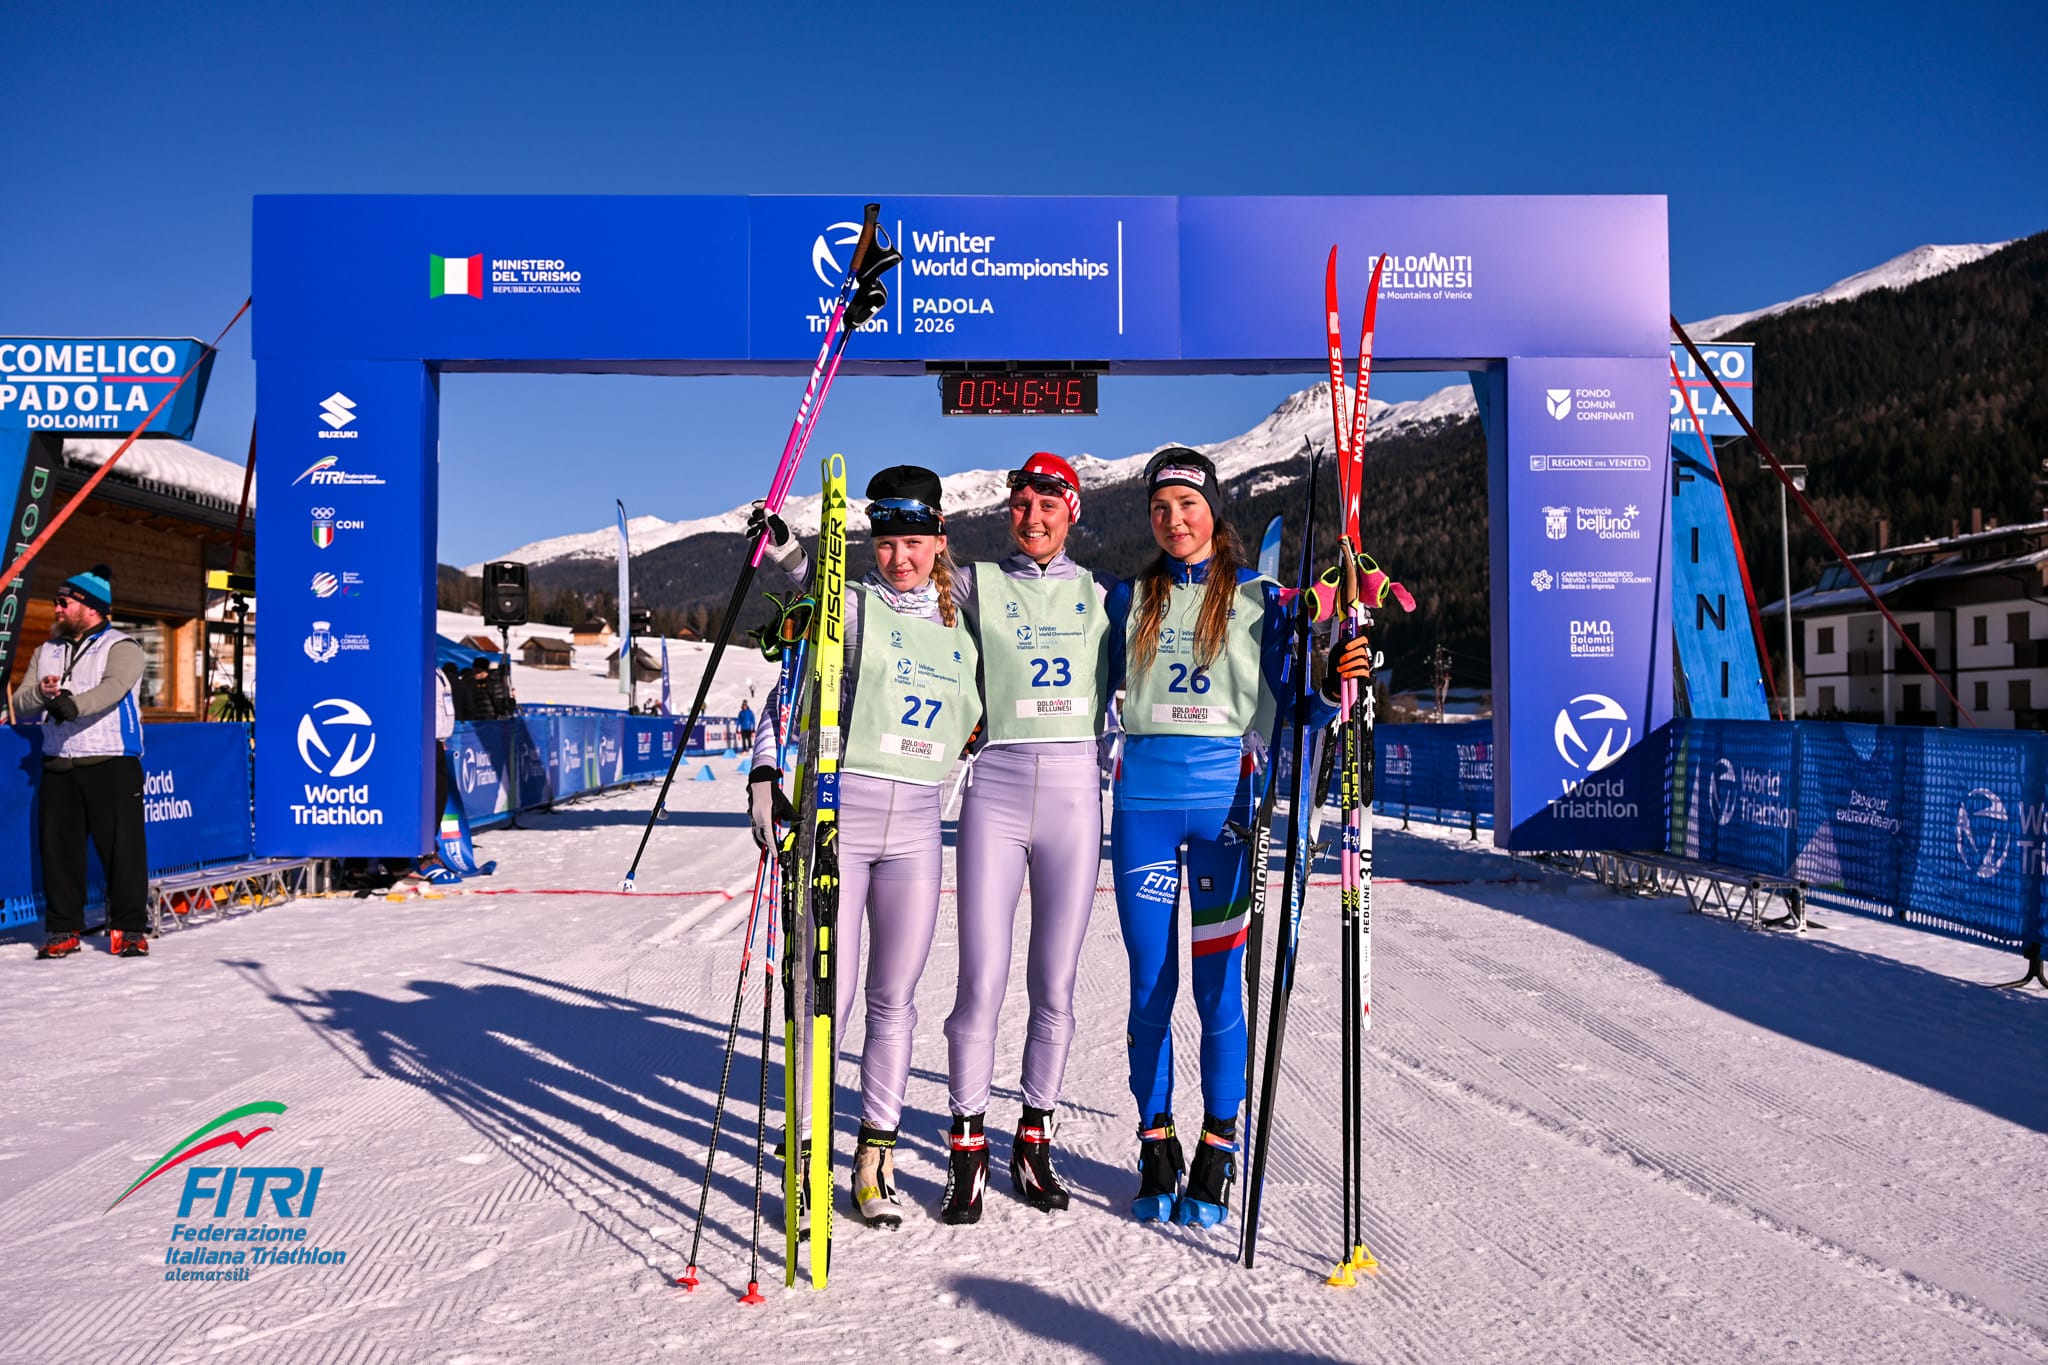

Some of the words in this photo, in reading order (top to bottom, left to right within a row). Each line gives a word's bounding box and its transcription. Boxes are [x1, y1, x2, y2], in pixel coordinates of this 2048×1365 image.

[912, 231, 995, 253] Winter
[492, 259, 565, 270] MINISTERO
[912, 258, 967, 276] World
[971, 258, 1109, 280] Championships
[1368, 252, 1472, 272] DOLOMITI
[492, 271, 518, 282] DEL
[521, 271, 581, 282] TURISMO
[493, 286, 542, 294] REPUBBLICA
[543, 286, 581, 294] ITALIANA
[1387, 291, 1431, 299] Mountains
[1433, 290, 1443, 299] of
[1444, 291, 1473, 299] Venice
[913, 299, 994, 314] PADOLA
[914, 318, 955, 333] 2026
[0, 345, 176, 374] COMELICO
[0, 385, 149, 412] PADOLA
[959, 380, 1081, 407] 00:46:46
[1576, 389, 1611, 398] FONDO
[1354, 356, 1371, 463] MADSHUS
[1576, 401, 1616, 409] COMUNI
[27, 414, 118, 429] DOLOMITI
[1576, 412, 1634, 421] CONFINANTI
[318, 431, 358, 439] SUZUKI
[1551, 458, 1593, 467] REGIONE
[1609, 458, 1646, 467] VENETO
[310, 471, 346, 485] FITRI
[1576, 507, 1612, 515] Provincia
[336, 520, 364, 529] CONI
[1576, 515, 1631, 534] belluno
[1599, 530, 1640, 539] dolomiti
[826, 517, 843, 644] FISCHER
[1570, 620, 1614, 635] D.M.O.
[1570, 635, 1614, 644] Dolomiti
[1570, 644, 1614, 653] Bellunesi
[1030, 657, 1072, 688] 23
[1168, 663, 1211, 694] 26
[1037, 699, 1072, 707] DOLOMITI
[1172, 706, 1208, 714] DOLOMITI
[900, 695, 943, 729] 27
[900, 744, 932, 755] BELLUNESI
[901, 738, 933, 750] DOLOMITI
[1561, 779, 1625, 798] World
[1740, 767, 1781, 797] World
[304, 784, 369, 804] World
[823, 791, 833, 803] 27
[1342, 771, 1350, 810] LEKI
[290, 805, 383, 825] Triathlon
[1548, 799, 1639, 818] Triathlon
[1740, 797, 1798, 829] Triathlon
[1254, 826, 1271, 915] SALOMON
[797, 858, 806, 917] FISCHER
[1143, 871, 1179, 893] FITR
[1363, 884, 1371, 934] REDLINE
[866, 1137, 897, 1146] FISCH
